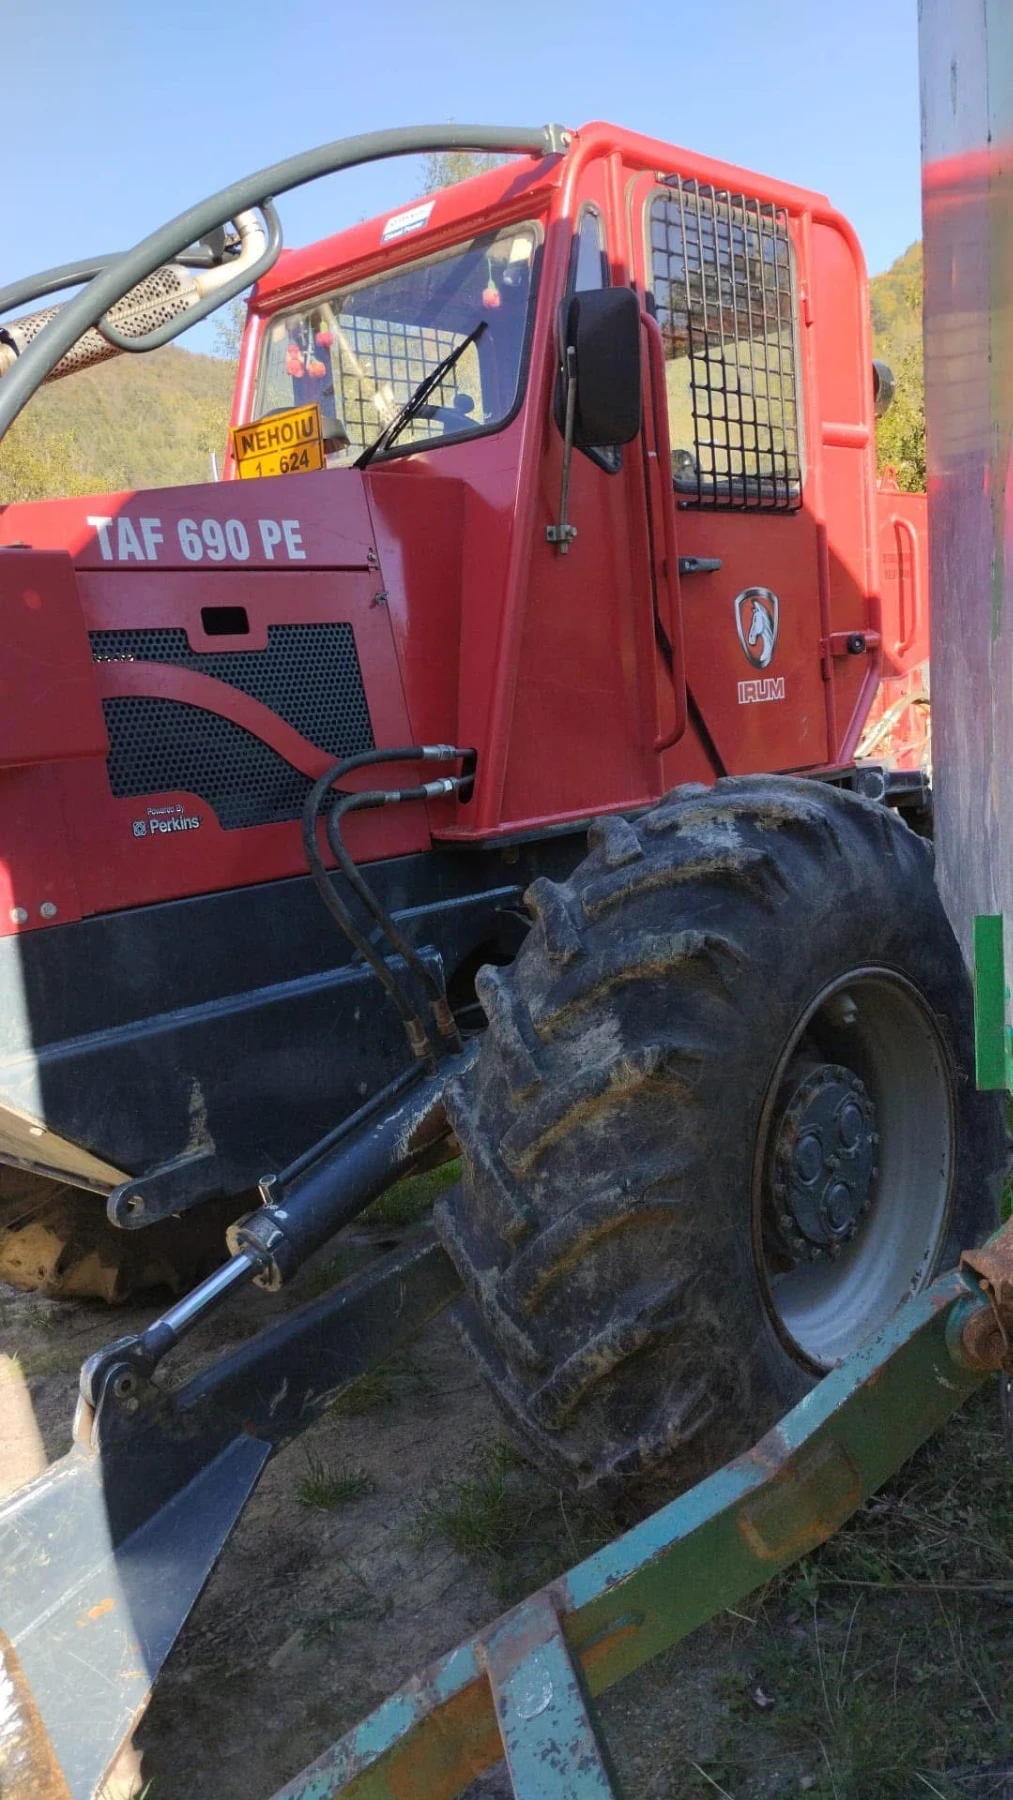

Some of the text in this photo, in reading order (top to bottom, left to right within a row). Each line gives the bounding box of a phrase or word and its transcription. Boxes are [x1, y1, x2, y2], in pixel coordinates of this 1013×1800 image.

[241, 416, 314, 455] NEHOIU
[279, 449, 309, 474] 624
[87, 516, 307, 562] TAF 690 PE
[737, 677, 785, 704] IRUM
[149, 816, 200, 835] Perkins
